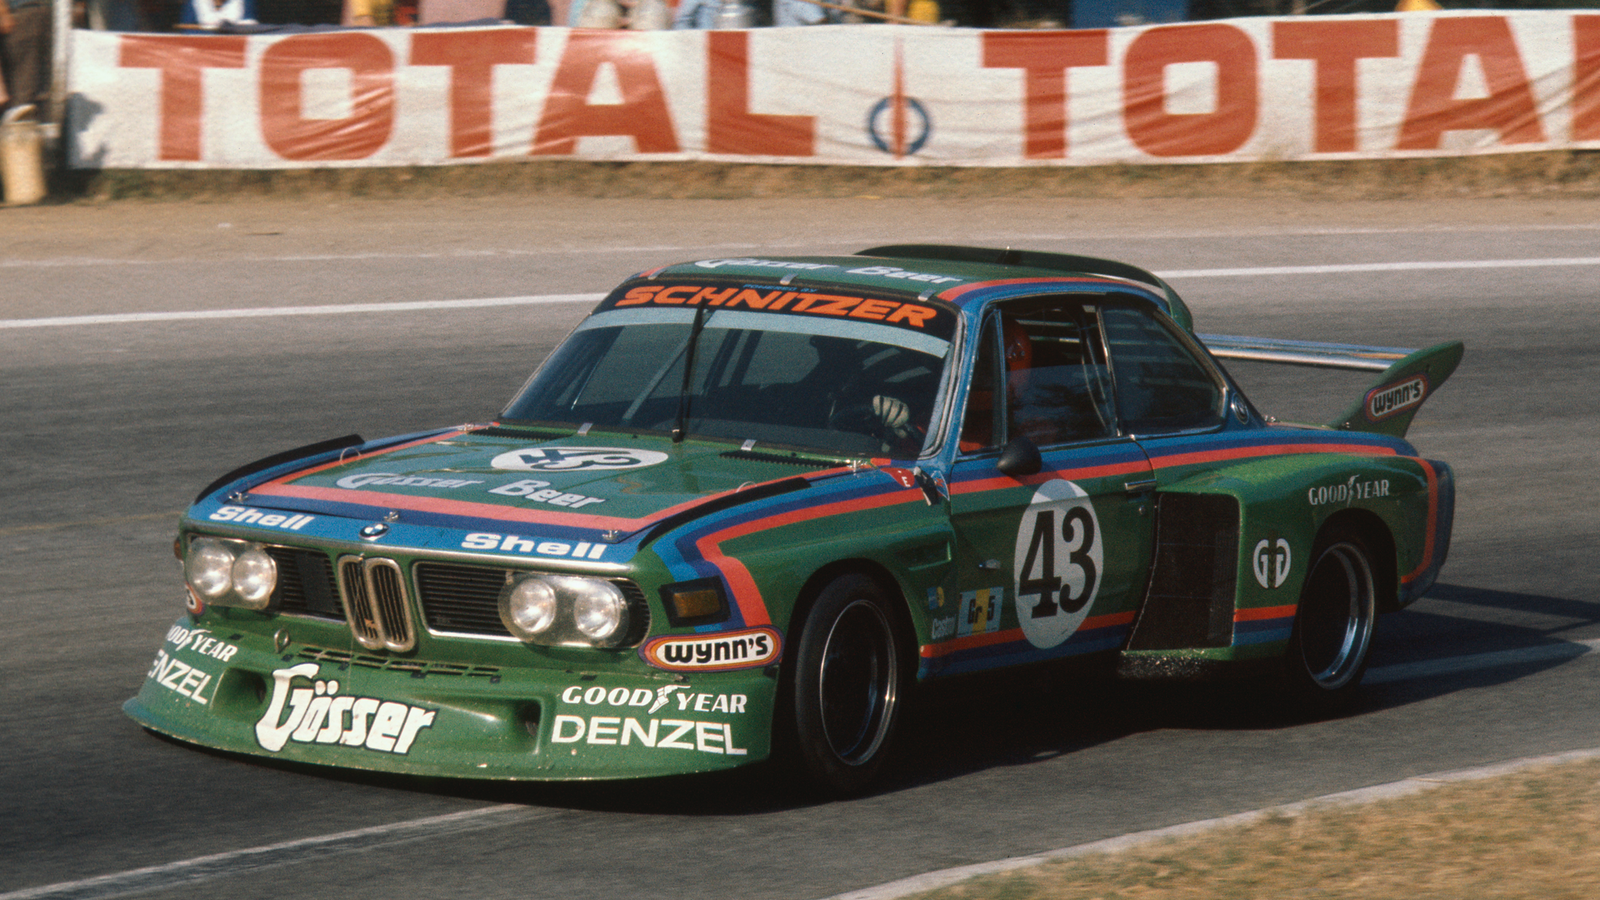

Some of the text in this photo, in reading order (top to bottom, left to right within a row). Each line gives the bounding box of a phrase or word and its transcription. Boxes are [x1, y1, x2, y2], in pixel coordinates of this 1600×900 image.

[118, 29, 816, 161] TOTAL
[742, 283, 798, 291] POWERED
[846, 266, 962, 284] Beer
[615, 286, 937, 327] SCHNITZER
[488, 478, 606, 509] Beer
[209, 506, 315, 530] Shell
[461, 532, 607, 559] Shell
[1018, 506, 1097, 619] 43
[664, 635, 768, 664] wynn's
[255, 662, 437, 755] Gösser
[551, 714, 748, 755] DENZEL
